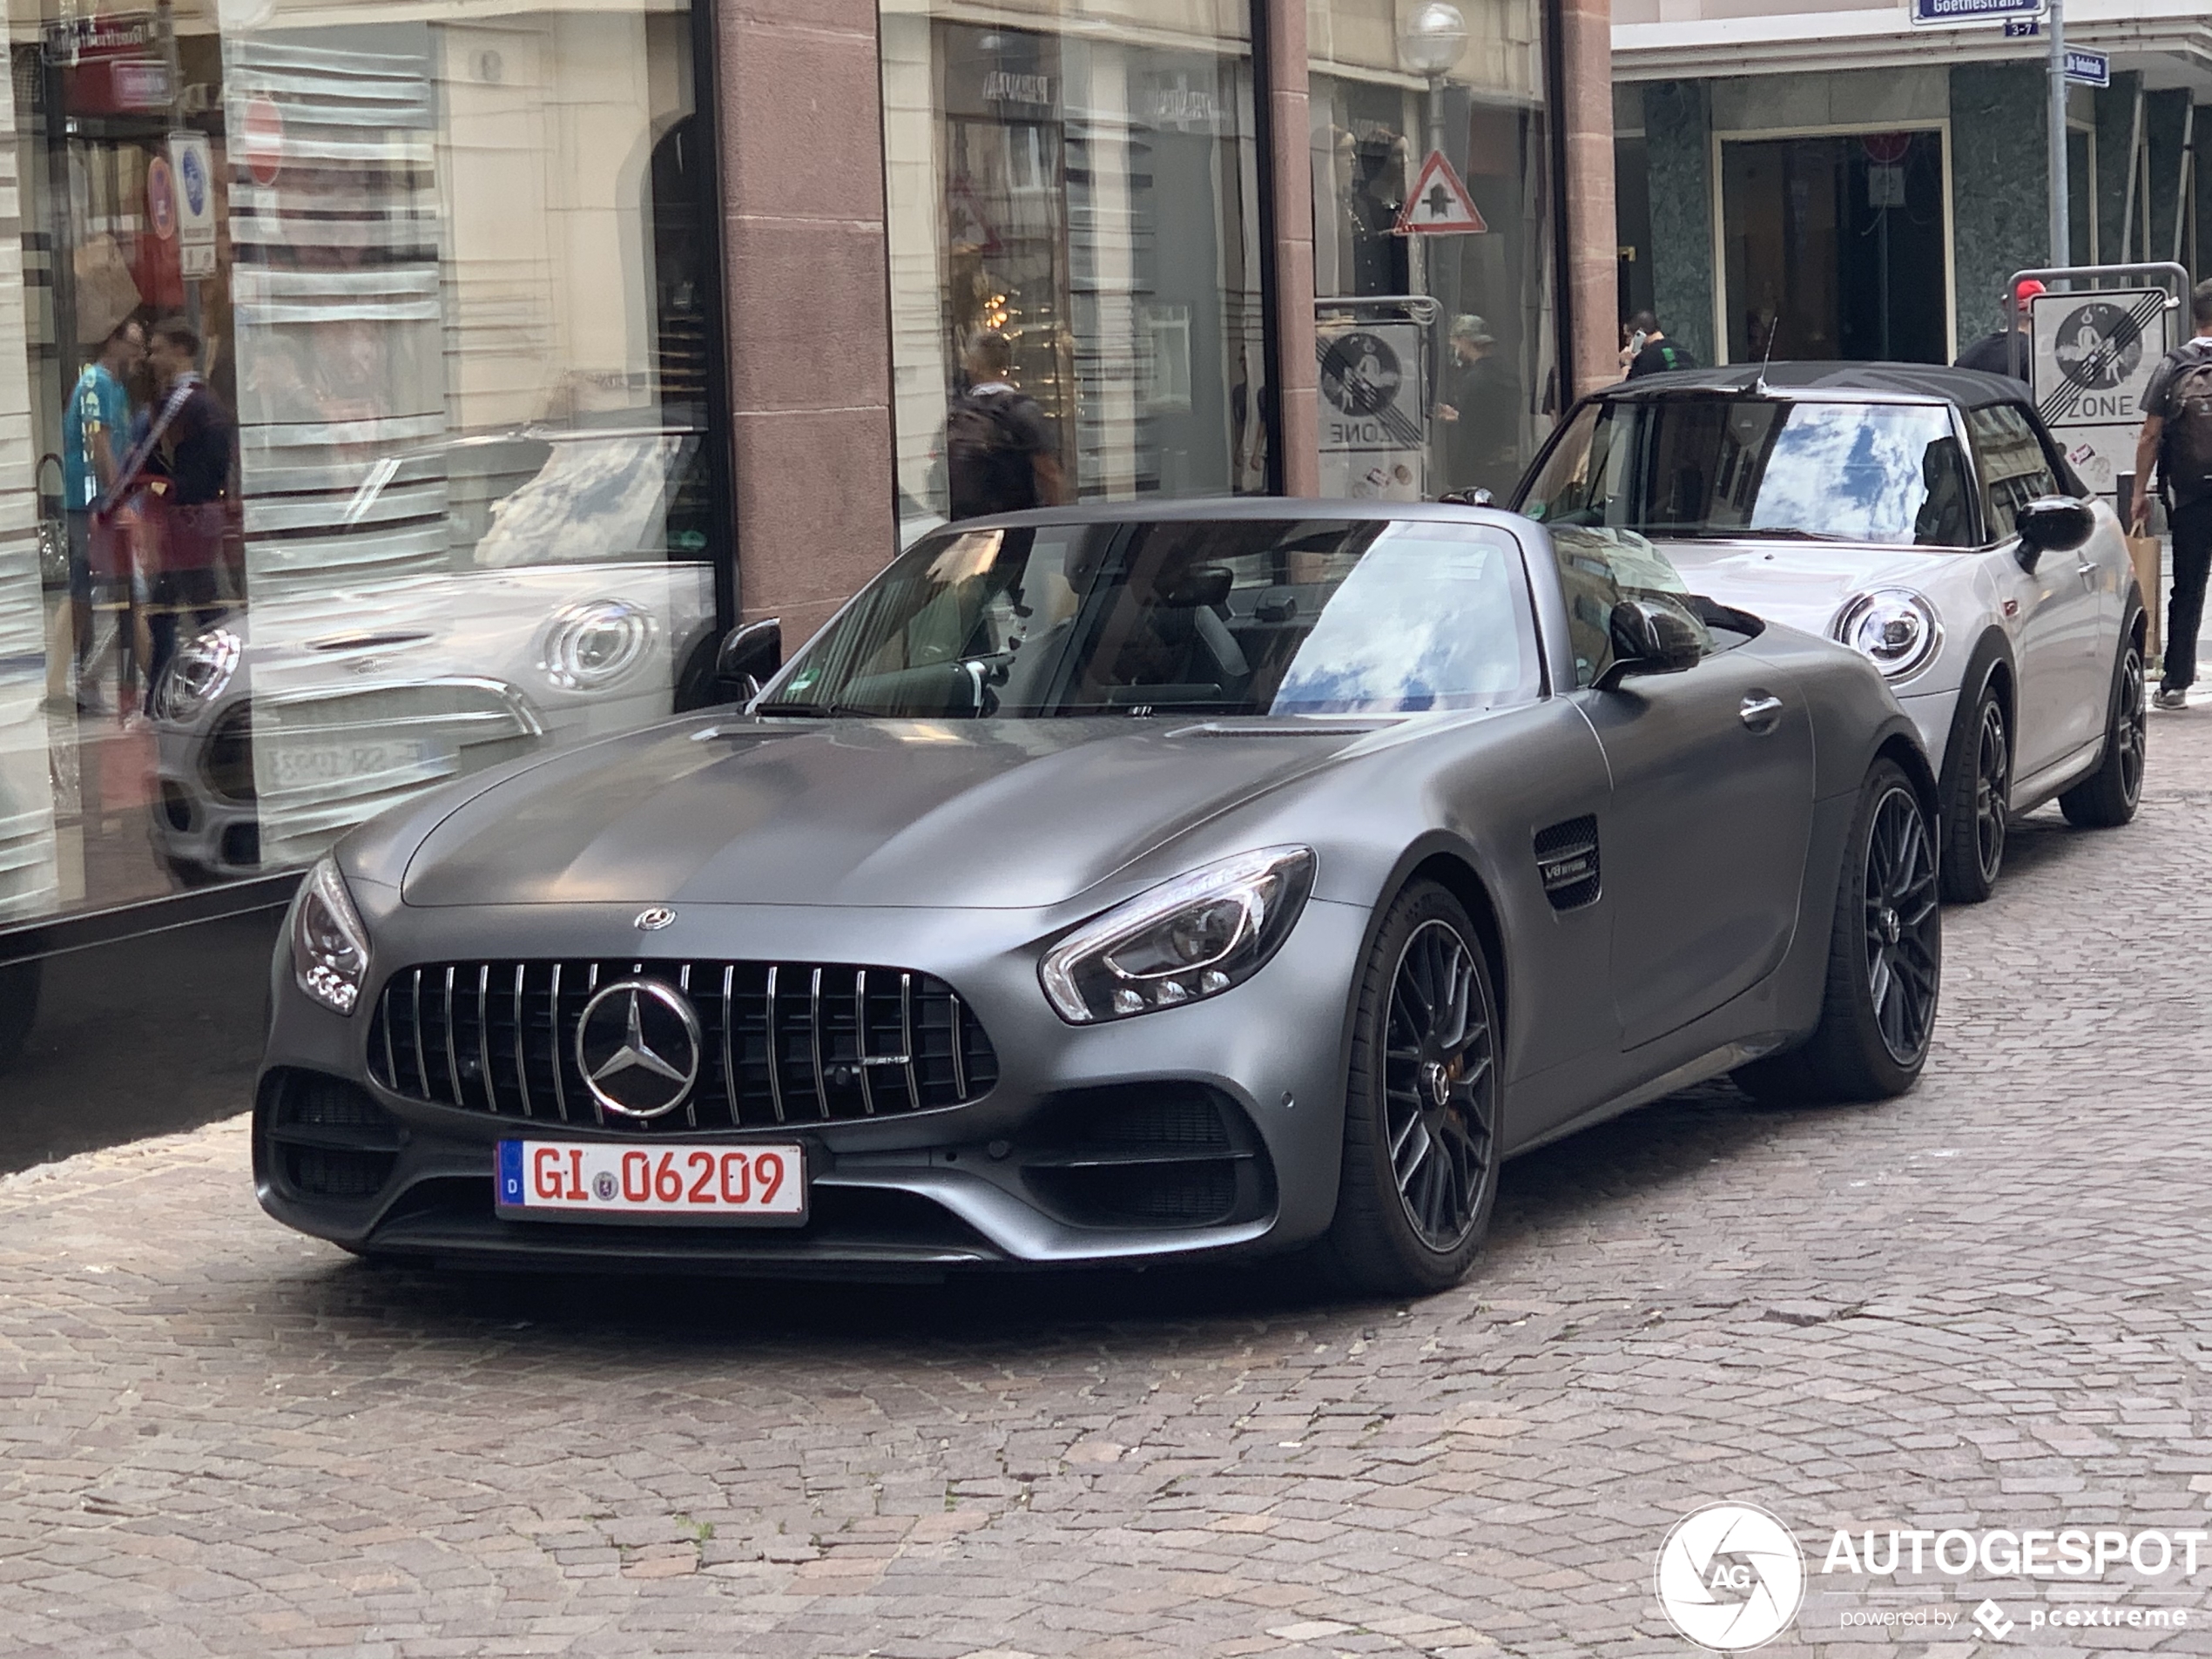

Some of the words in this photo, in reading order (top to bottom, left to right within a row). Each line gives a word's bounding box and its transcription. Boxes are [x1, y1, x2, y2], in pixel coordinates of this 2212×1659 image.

[2012, 24, 2033, 36] 3-7
[2067, 395, 2134, 418] ZONE
[534, 1148, 589, 1201] GI
[622, 1151, 784, 1204] 06209
[508, 1179, 517, 1194] D
